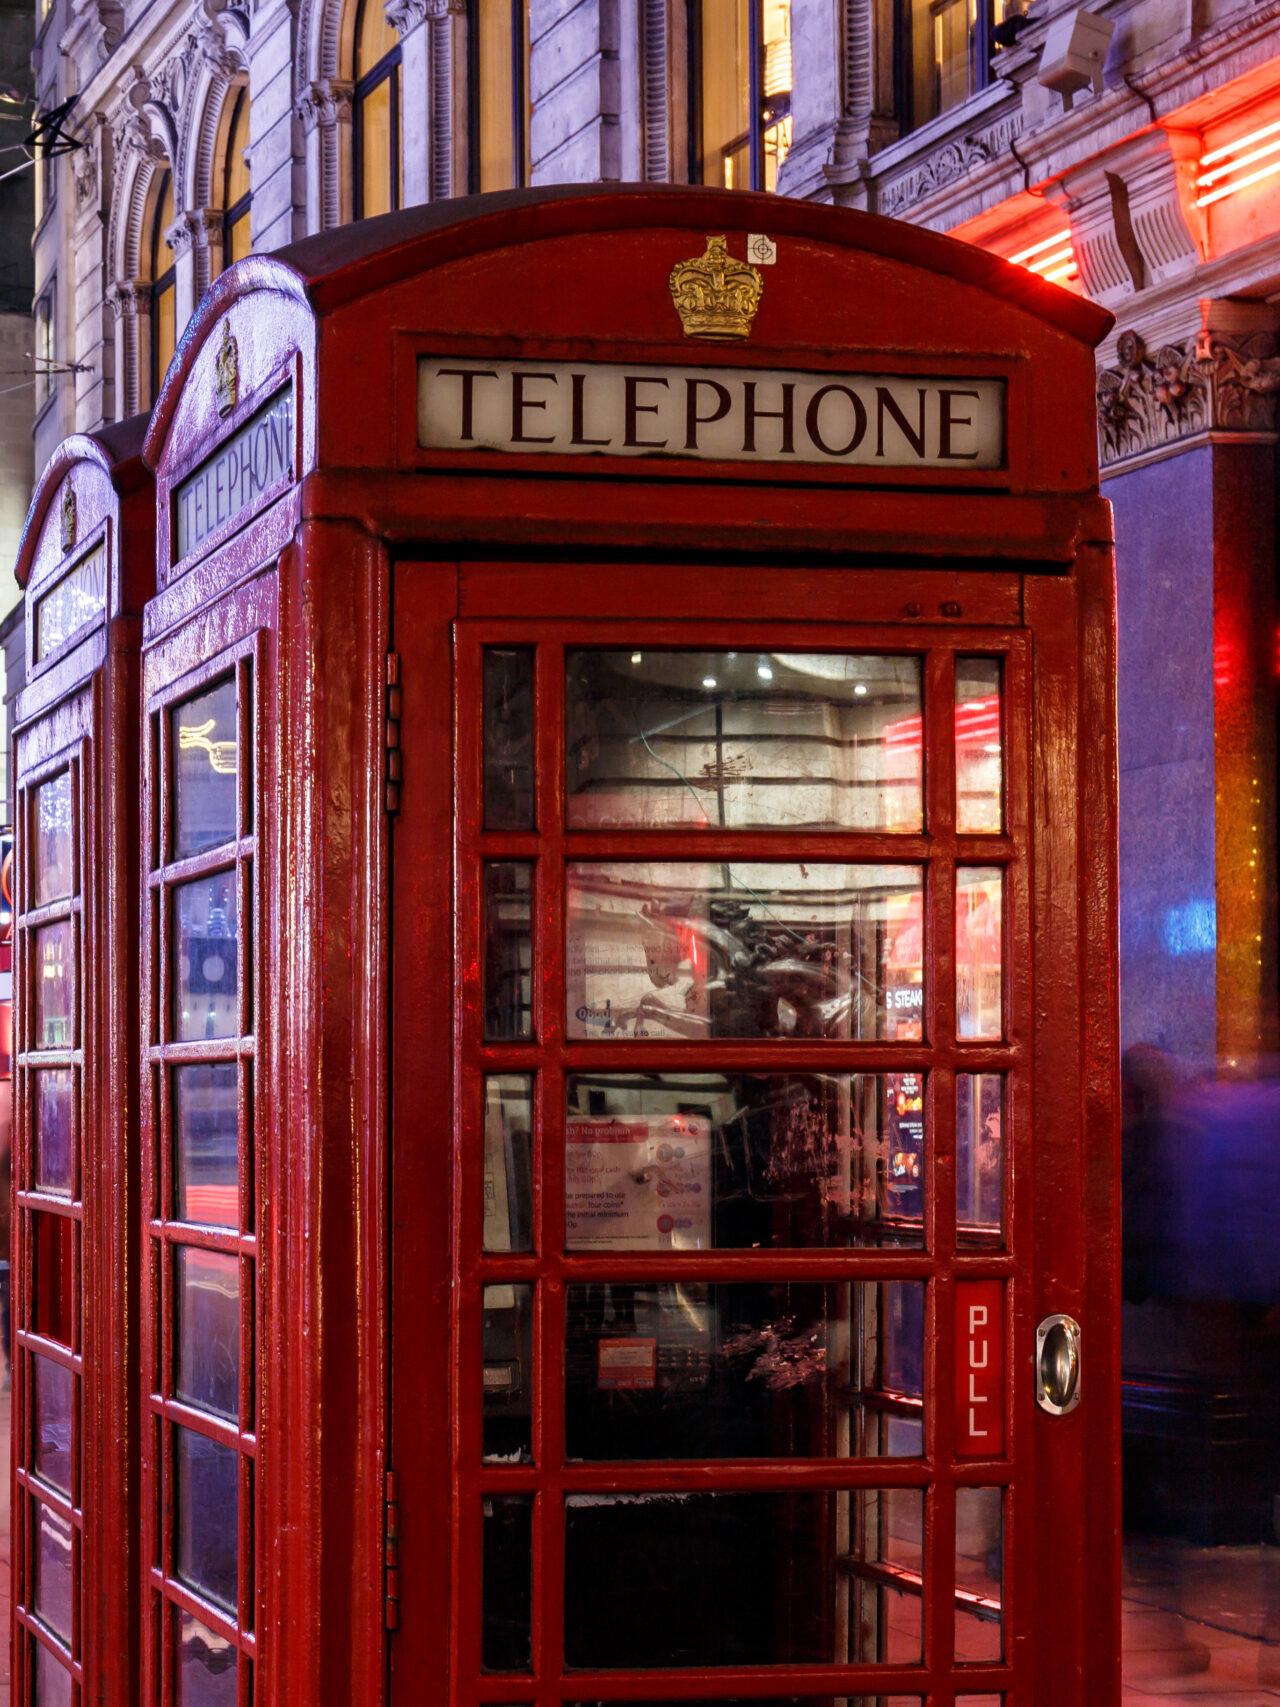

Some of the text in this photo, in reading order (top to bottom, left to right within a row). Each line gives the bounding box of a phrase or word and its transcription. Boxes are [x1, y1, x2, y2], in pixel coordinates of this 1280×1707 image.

[182, 398, 293, 551] TELEPHONE
[435, 367, 981, 460] TELEPHONE
[969, 1305, 988, 1436] PULL
